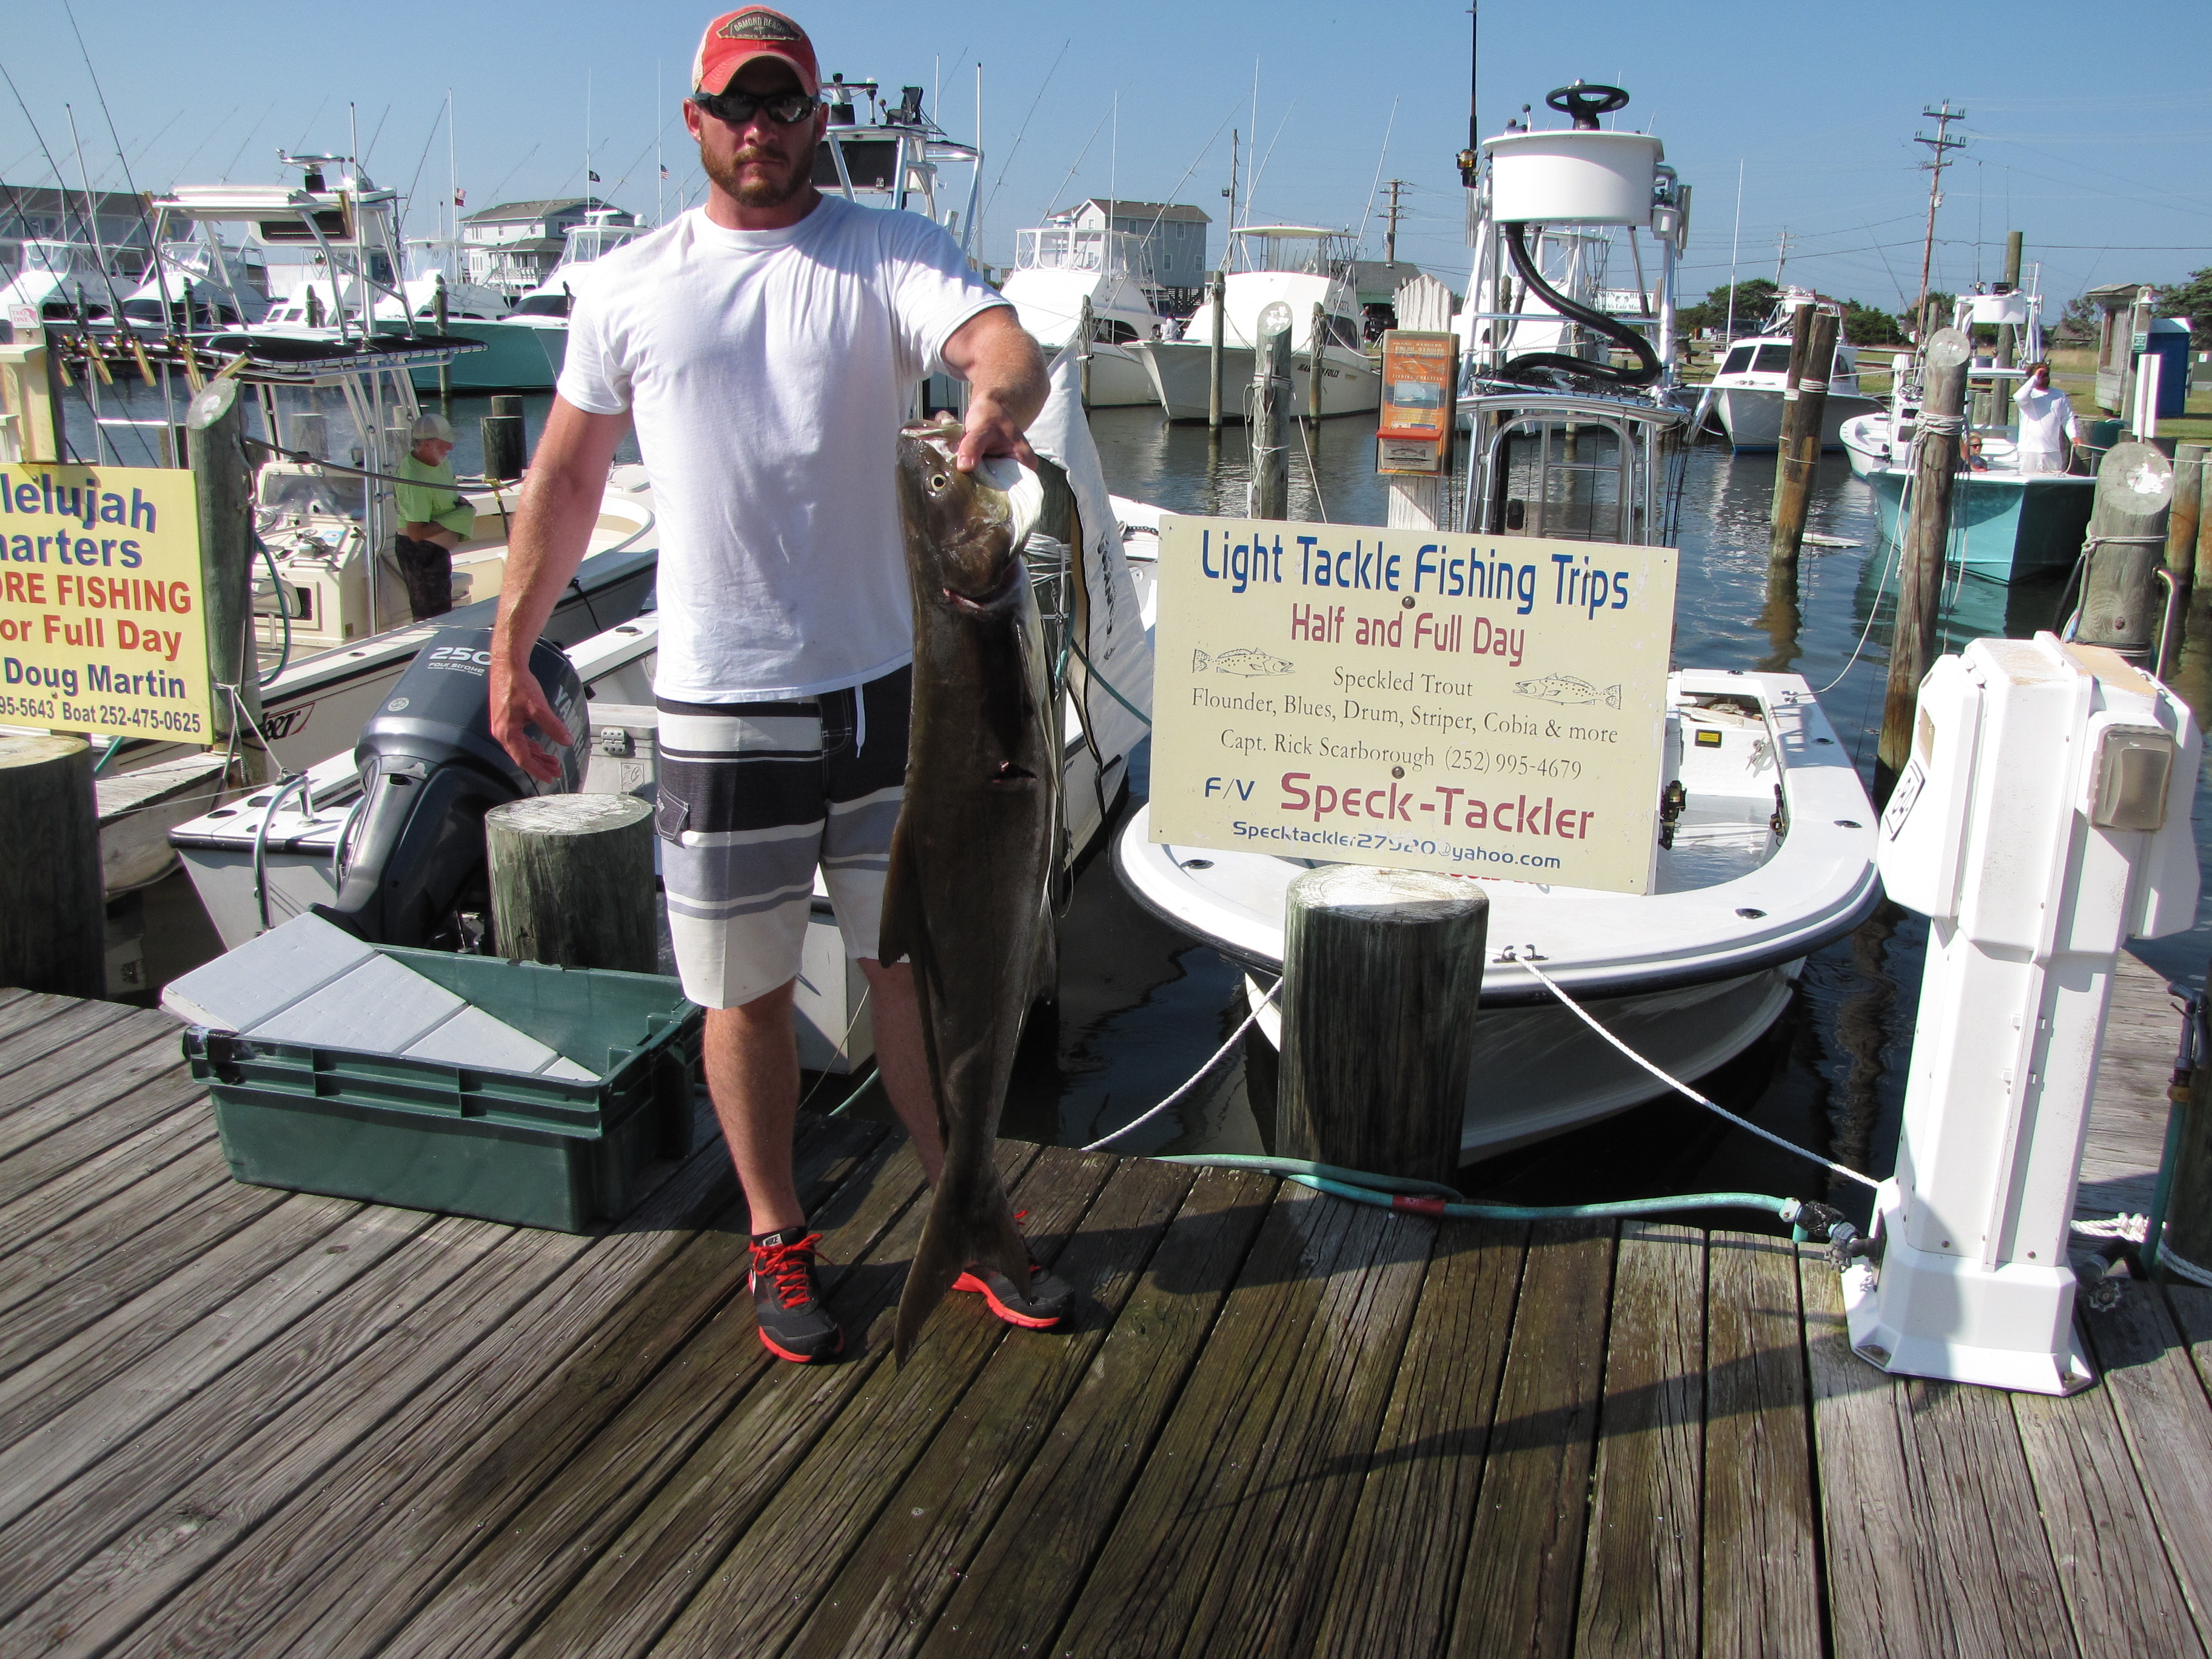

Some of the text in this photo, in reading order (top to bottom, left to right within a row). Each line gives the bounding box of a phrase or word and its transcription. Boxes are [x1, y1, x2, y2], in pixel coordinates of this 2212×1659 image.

[734, 17, 786, 33] ORMOND BEACH
[0, 571, 192, 614] RE FISHING
[1202, 529, 1629, 621] Light Tackle Fishing Trips
[0, 614, 182, 662] or Full Day
[429, 646, 492, 666] 250
[1291, 603, 1525, 668] Half and Full Day
[4, 657, 186, 699] Doug Martin
[1333, 666, 1473, 697] Speckled Trout
[0, 695, 201, 733] 95-5643 Boat 252-475-0625
[1193, 688, 1618, 743] Flounder, Blues, Drum, Striper, Cobia & more
[1221, 729, 1581, 780] Capt. Rick Scarborough (252) 995-4679
[1204, 772, 1595, 841] F/V Speck-Tackler
